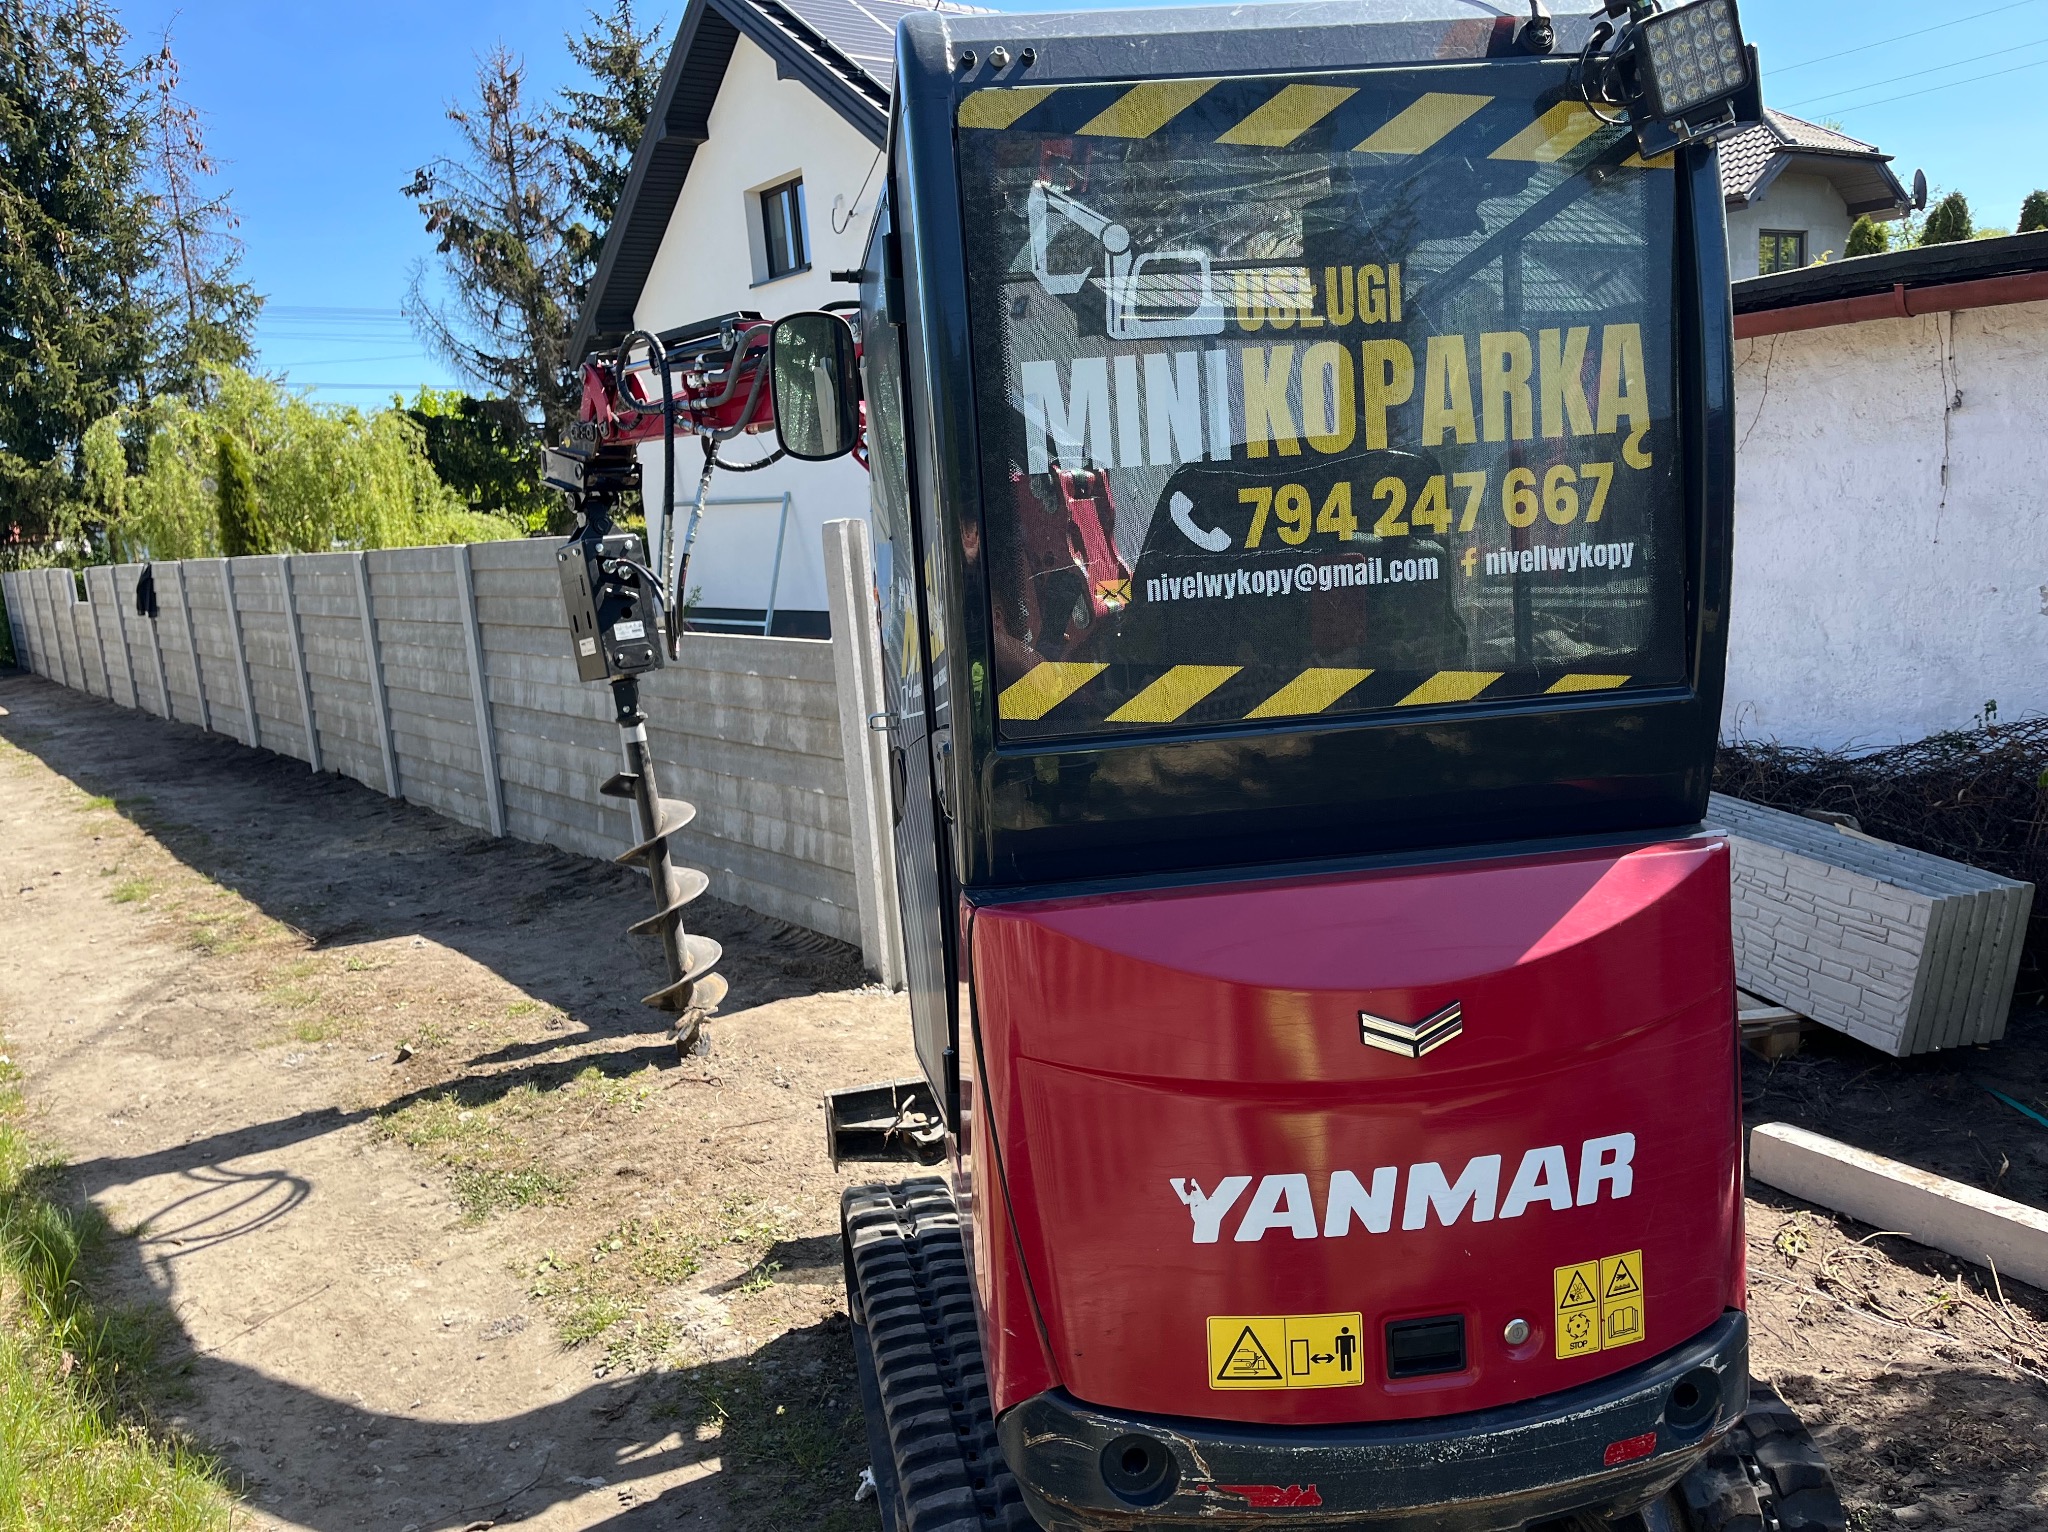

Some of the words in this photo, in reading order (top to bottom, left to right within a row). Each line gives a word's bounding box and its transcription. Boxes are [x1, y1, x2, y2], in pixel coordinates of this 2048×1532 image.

[1234, 262, 1402, 333] USŁUGI
[1021, 349, 1232, 475] MINI
[1241, 323, 1653, 470] KOPARKĄ
[1238, 484, 1357, 549] 794
[1371, 473, 1487, 541] 247
[1502, 463, 1615, 528] 667
[1146, 557, 1439, 602] nivelwykopy@gmail.com
[1485, 542, 1635, 576] nivellwykopy
[1170, 1132, 1636, 1243] YANMAR
[1569, 1339, 1588, 1351] STOP
